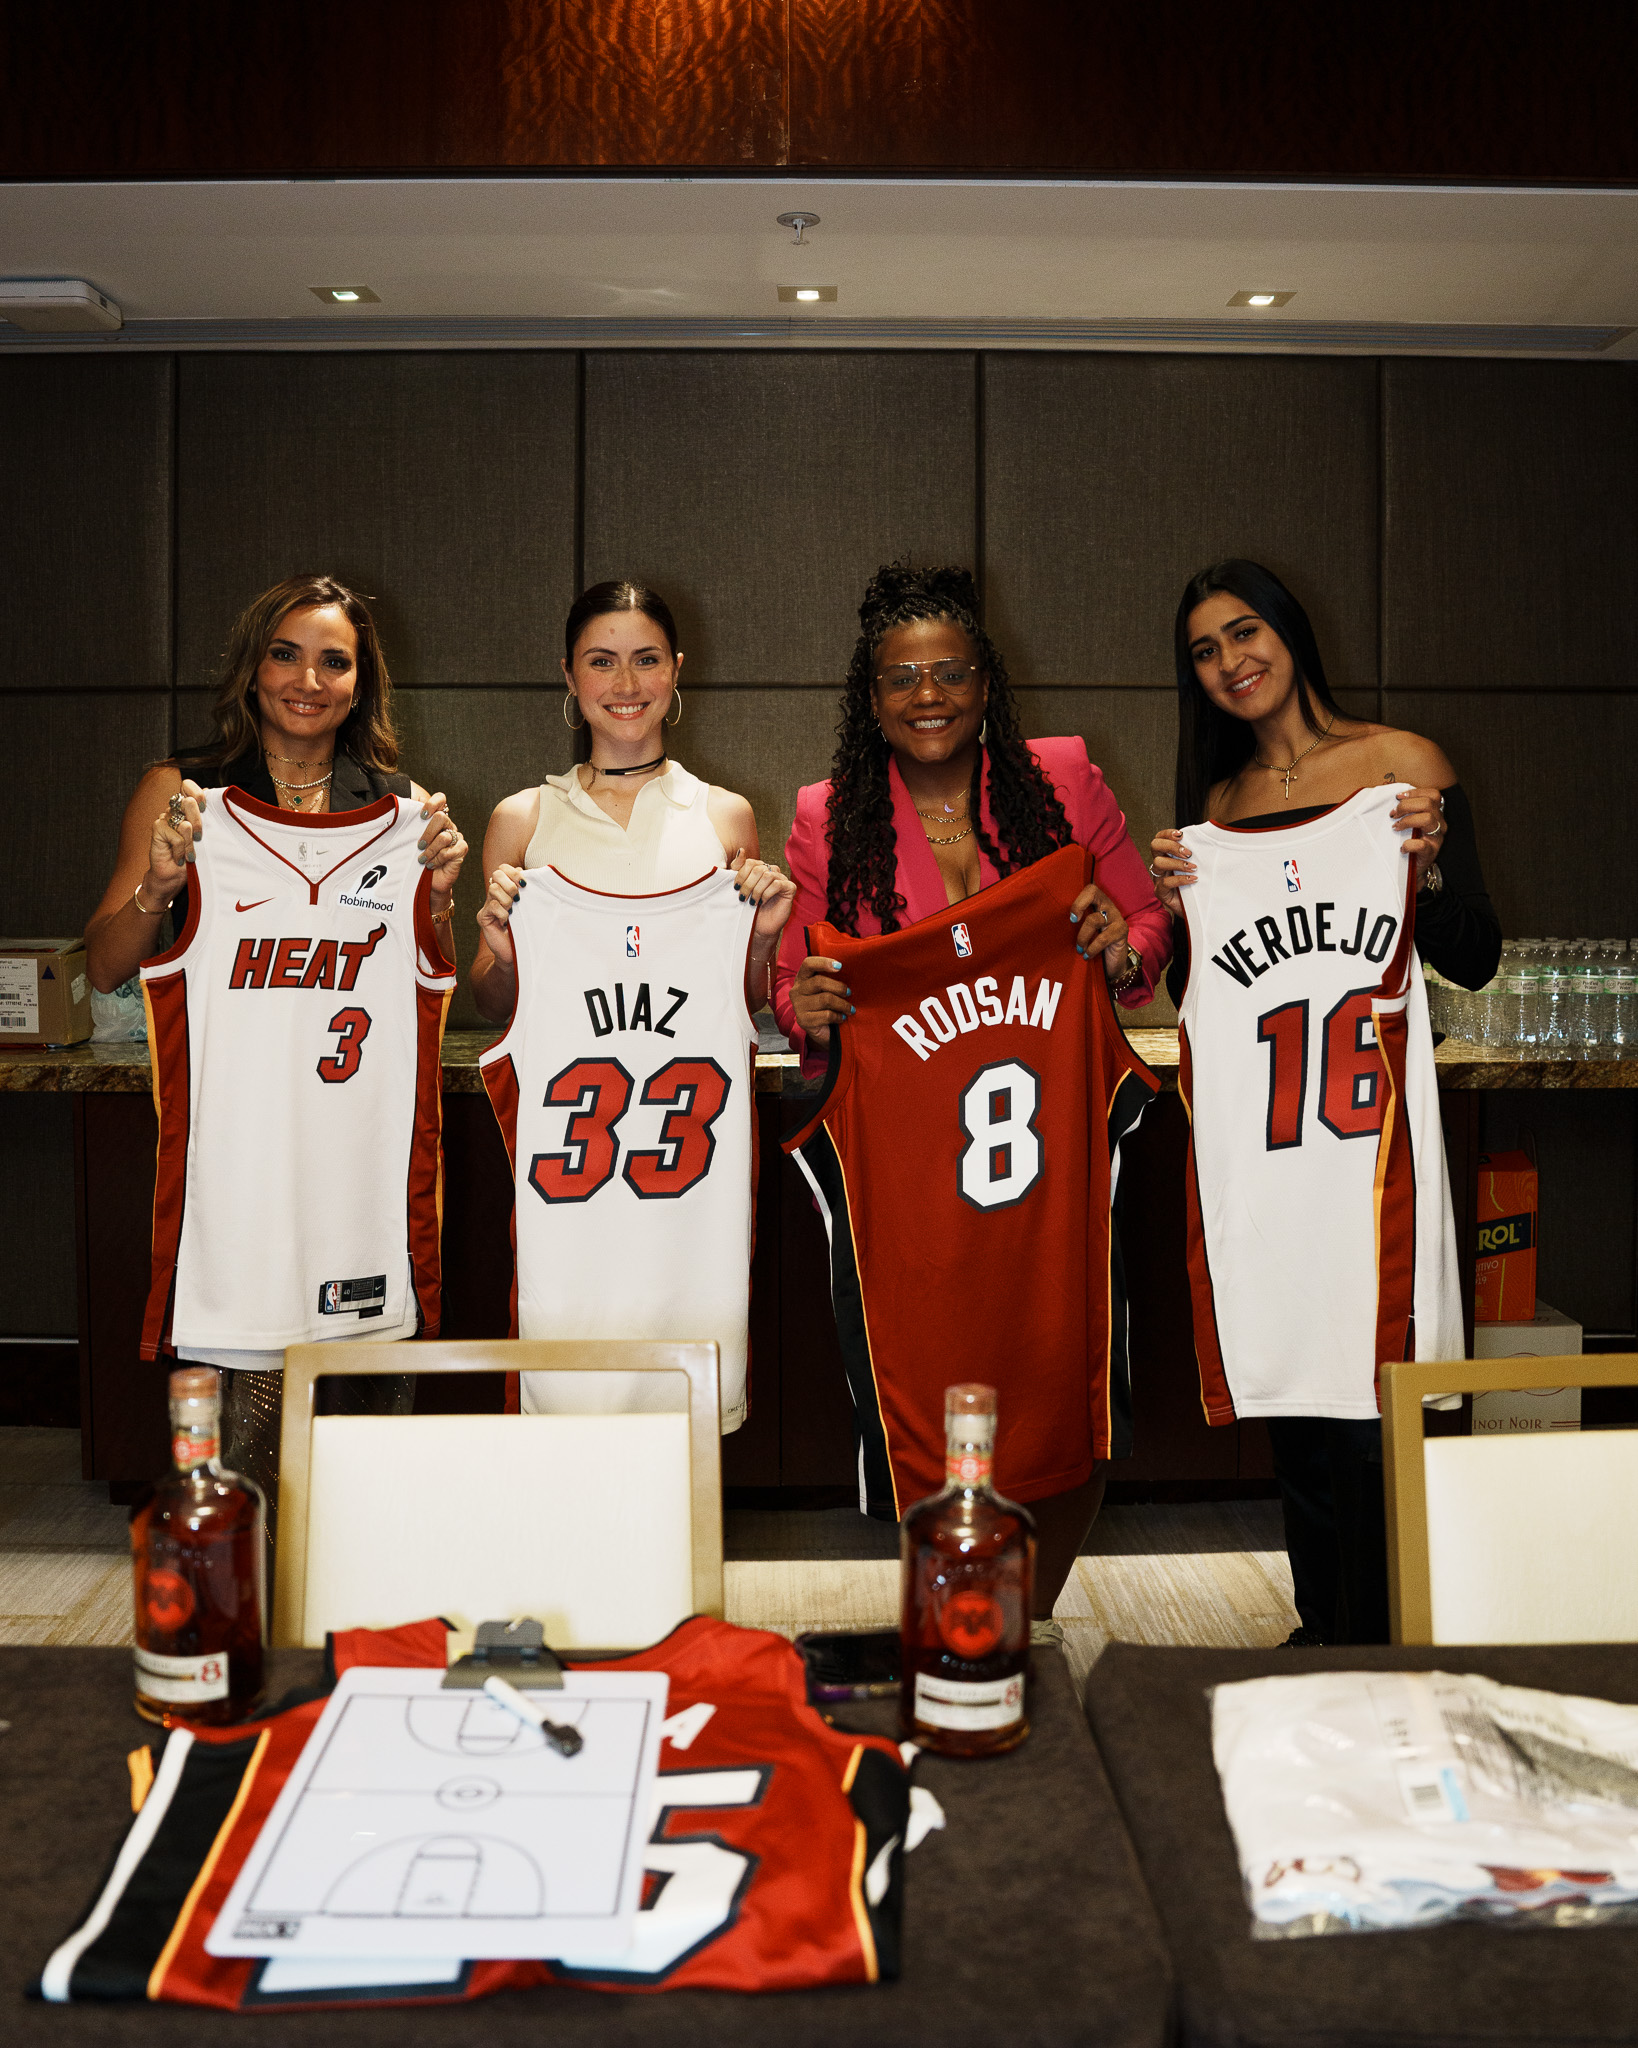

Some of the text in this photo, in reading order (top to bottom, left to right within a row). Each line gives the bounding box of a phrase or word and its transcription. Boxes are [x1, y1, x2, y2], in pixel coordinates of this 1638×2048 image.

[339, 894, 394, 912] Robinhood
[228, 921, 388, 991] HEAT
[1211, 902, 1398, 989] VERDEJO
[316, 1006, 372, 1083] 3
[584, 982, 689, 1038] DIAZ
[891, 975, 1063, 1062] RODSAN
[1257, 984, 1386, 1152] 16
[527, 1056, 732, 1204] 33
[956, 1057, 1045, 1214] 8
[1476, 1223, 1520, 1251] ROL
[1473, 1419, 1504, 1430] INOT
[201, 1660, 222, 1685] 8
